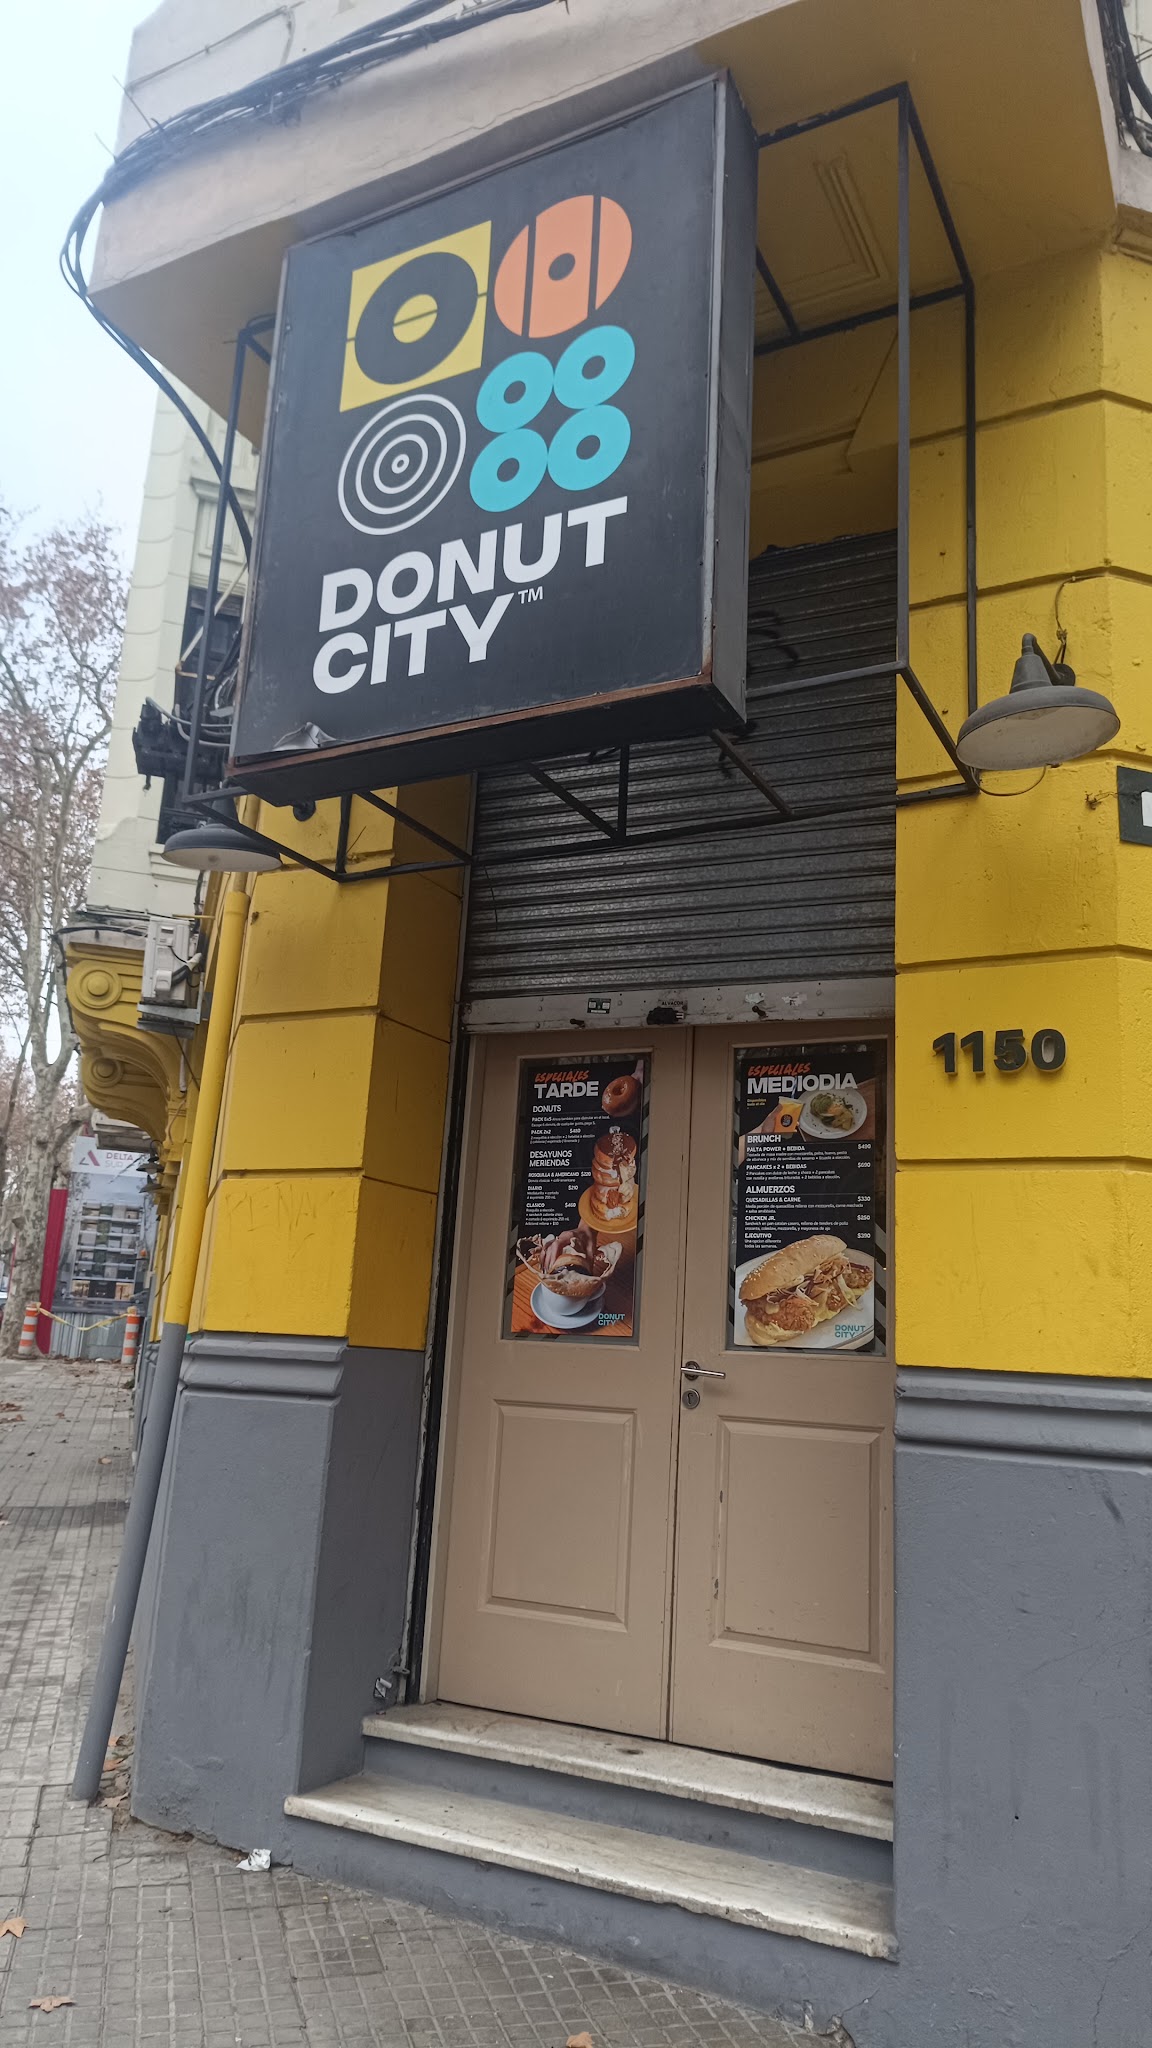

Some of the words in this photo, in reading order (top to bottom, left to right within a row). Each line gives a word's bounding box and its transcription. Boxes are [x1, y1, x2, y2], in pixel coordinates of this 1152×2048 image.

[318, 496, 628, 633] DONUT
[311, 592, 515, 695] CITY
[932, 1028, 1068, 1076] 1150
[748, 1062, 811, 1076] ESPECIALES
[534, 1070, 589, 1082] ESPECIALES
[534, 1080, 599, 1098] TARDE
[747, 1072, 858, 1094] MEDIODIA
[747, 1135, 781, 1143] BRUNCH
[106, 1152, 133, 1160] DELTA
[530, 1150, 572, 1158] DESAYUNOS
[529, 1159, 570, 1167] MERIENDAS
[746, 1185, 795, 1194] ALMUERZOS
